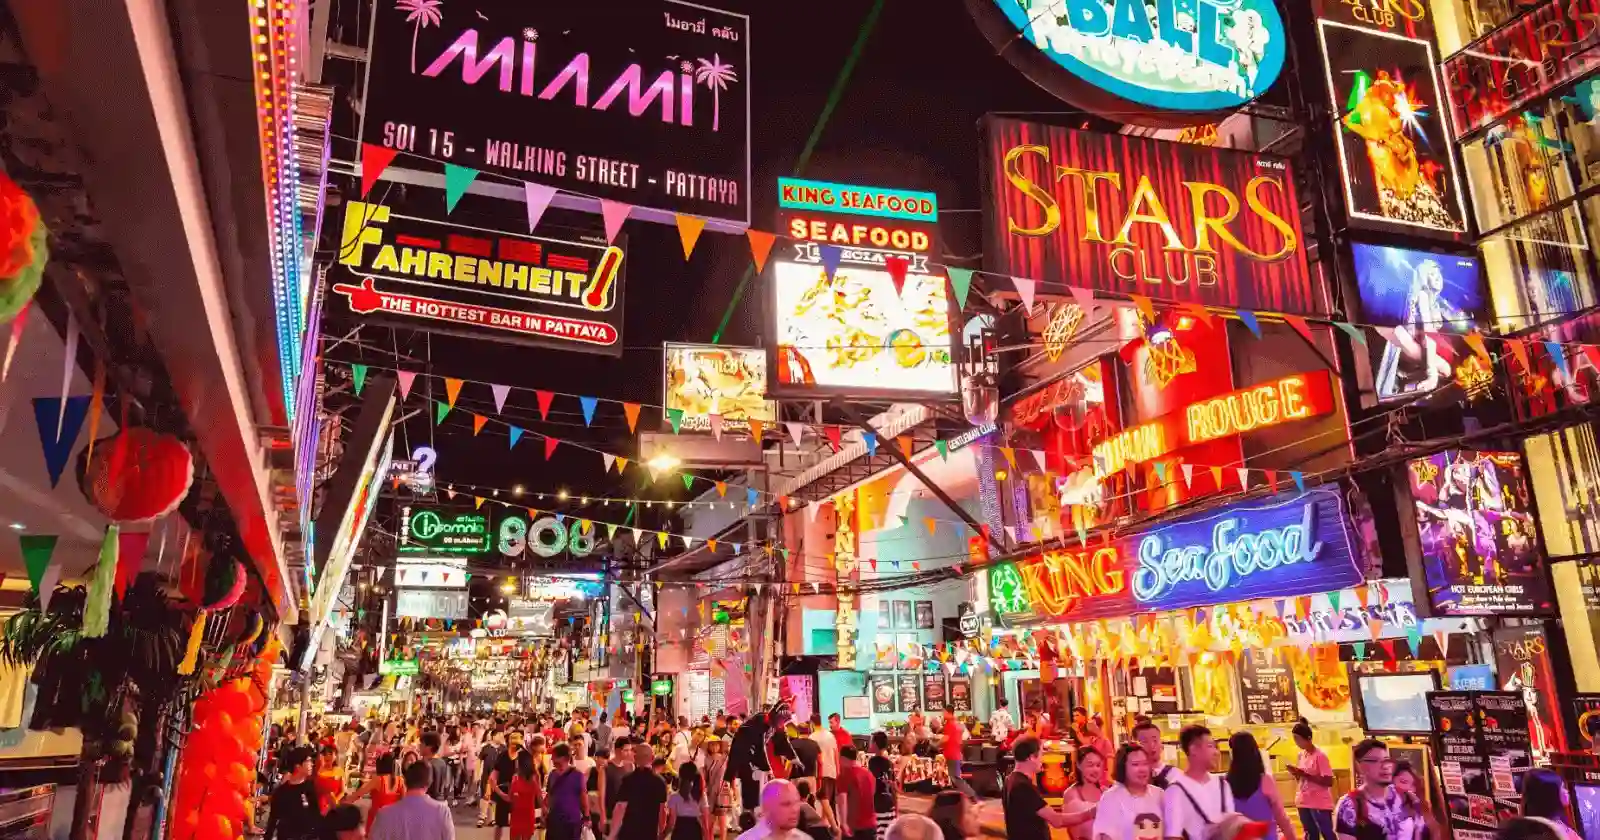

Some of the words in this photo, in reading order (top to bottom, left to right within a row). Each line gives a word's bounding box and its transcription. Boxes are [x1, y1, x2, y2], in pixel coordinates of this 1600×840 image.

[1352, 6, 1395, 28] CLUB
[383, 121, 415, 152] SOI
[430, 129, 454, 158] 15
[486, 138, 567, 178] WALKING
[576, 155, 641, 189] STREET
[666, 171, 739, 205] PATTAYA
[783, 185, 835, 205] KING
[841, 191, 933, 215] SEAFOOD
[1003, 144, 1297, 263] STARS
[339, 200, 587, 298] FAHRENHEIT
[791, 218, 929, 251] SEAFOOD
[1111, 247, 1218, 288] CLUB
[380, 295, 411, 313] THE
[415, 301, 485, 323] HOTTEST
[490, 312, 521, 328] BAR
[526, 316, 542, 331] IN
[545, 319, 608, 340] PATTAYA
[1187, 378, 1307, 442] ROUGE
[499, 516, 596, 558] 808
[1020, 548, 1126, 616] KING
[1468, 585, 1504, 595] EUROPEAN
[1505, 585, 1525, 595] GIRLS
[1496, 636, 1545, 656] STARS
